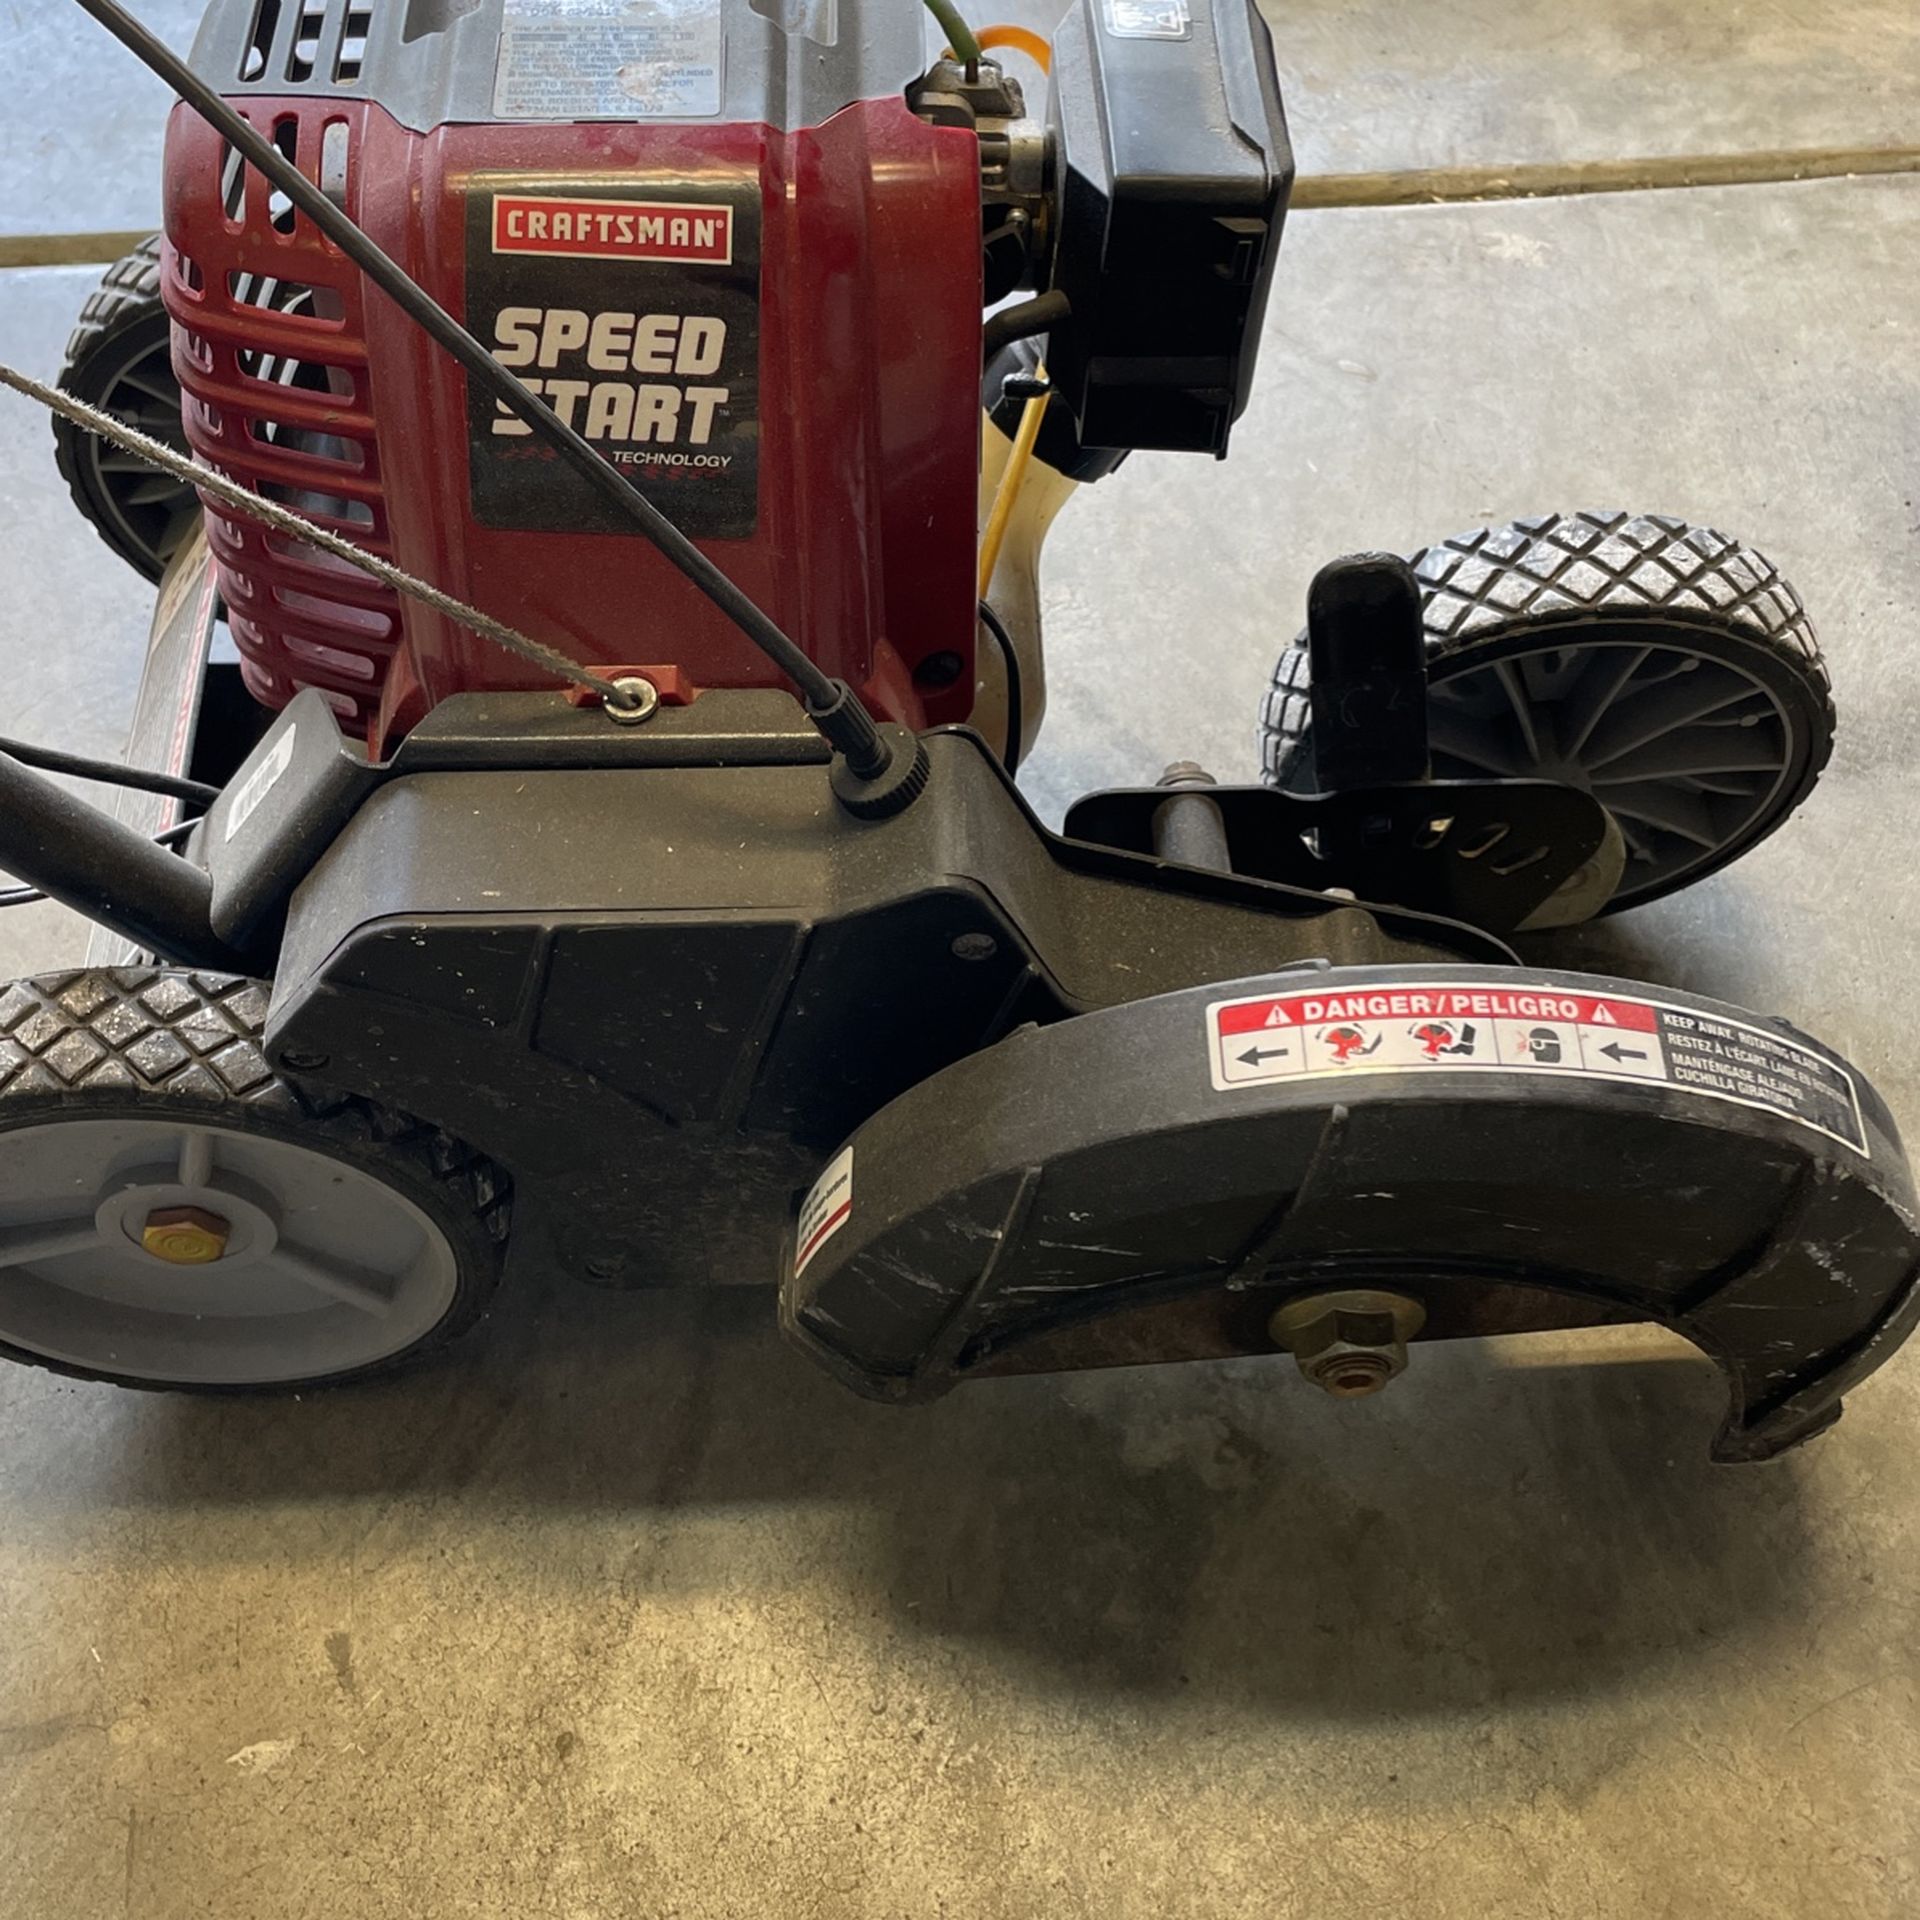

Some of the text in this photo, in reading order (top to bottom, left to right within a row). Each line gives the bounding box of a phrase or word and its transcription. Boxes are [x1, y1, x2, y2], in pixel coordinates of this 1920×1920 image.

[491, 306, 728, 376] SPEED
[612, 450, 732, 469] TECHNOLOGY
[1662, 1012, 1695, 1030] KEEP
[1667, 1032, 1713, 1054] RESTEZ
[1674, 1066, 1736, 1091] CUCHILLA
